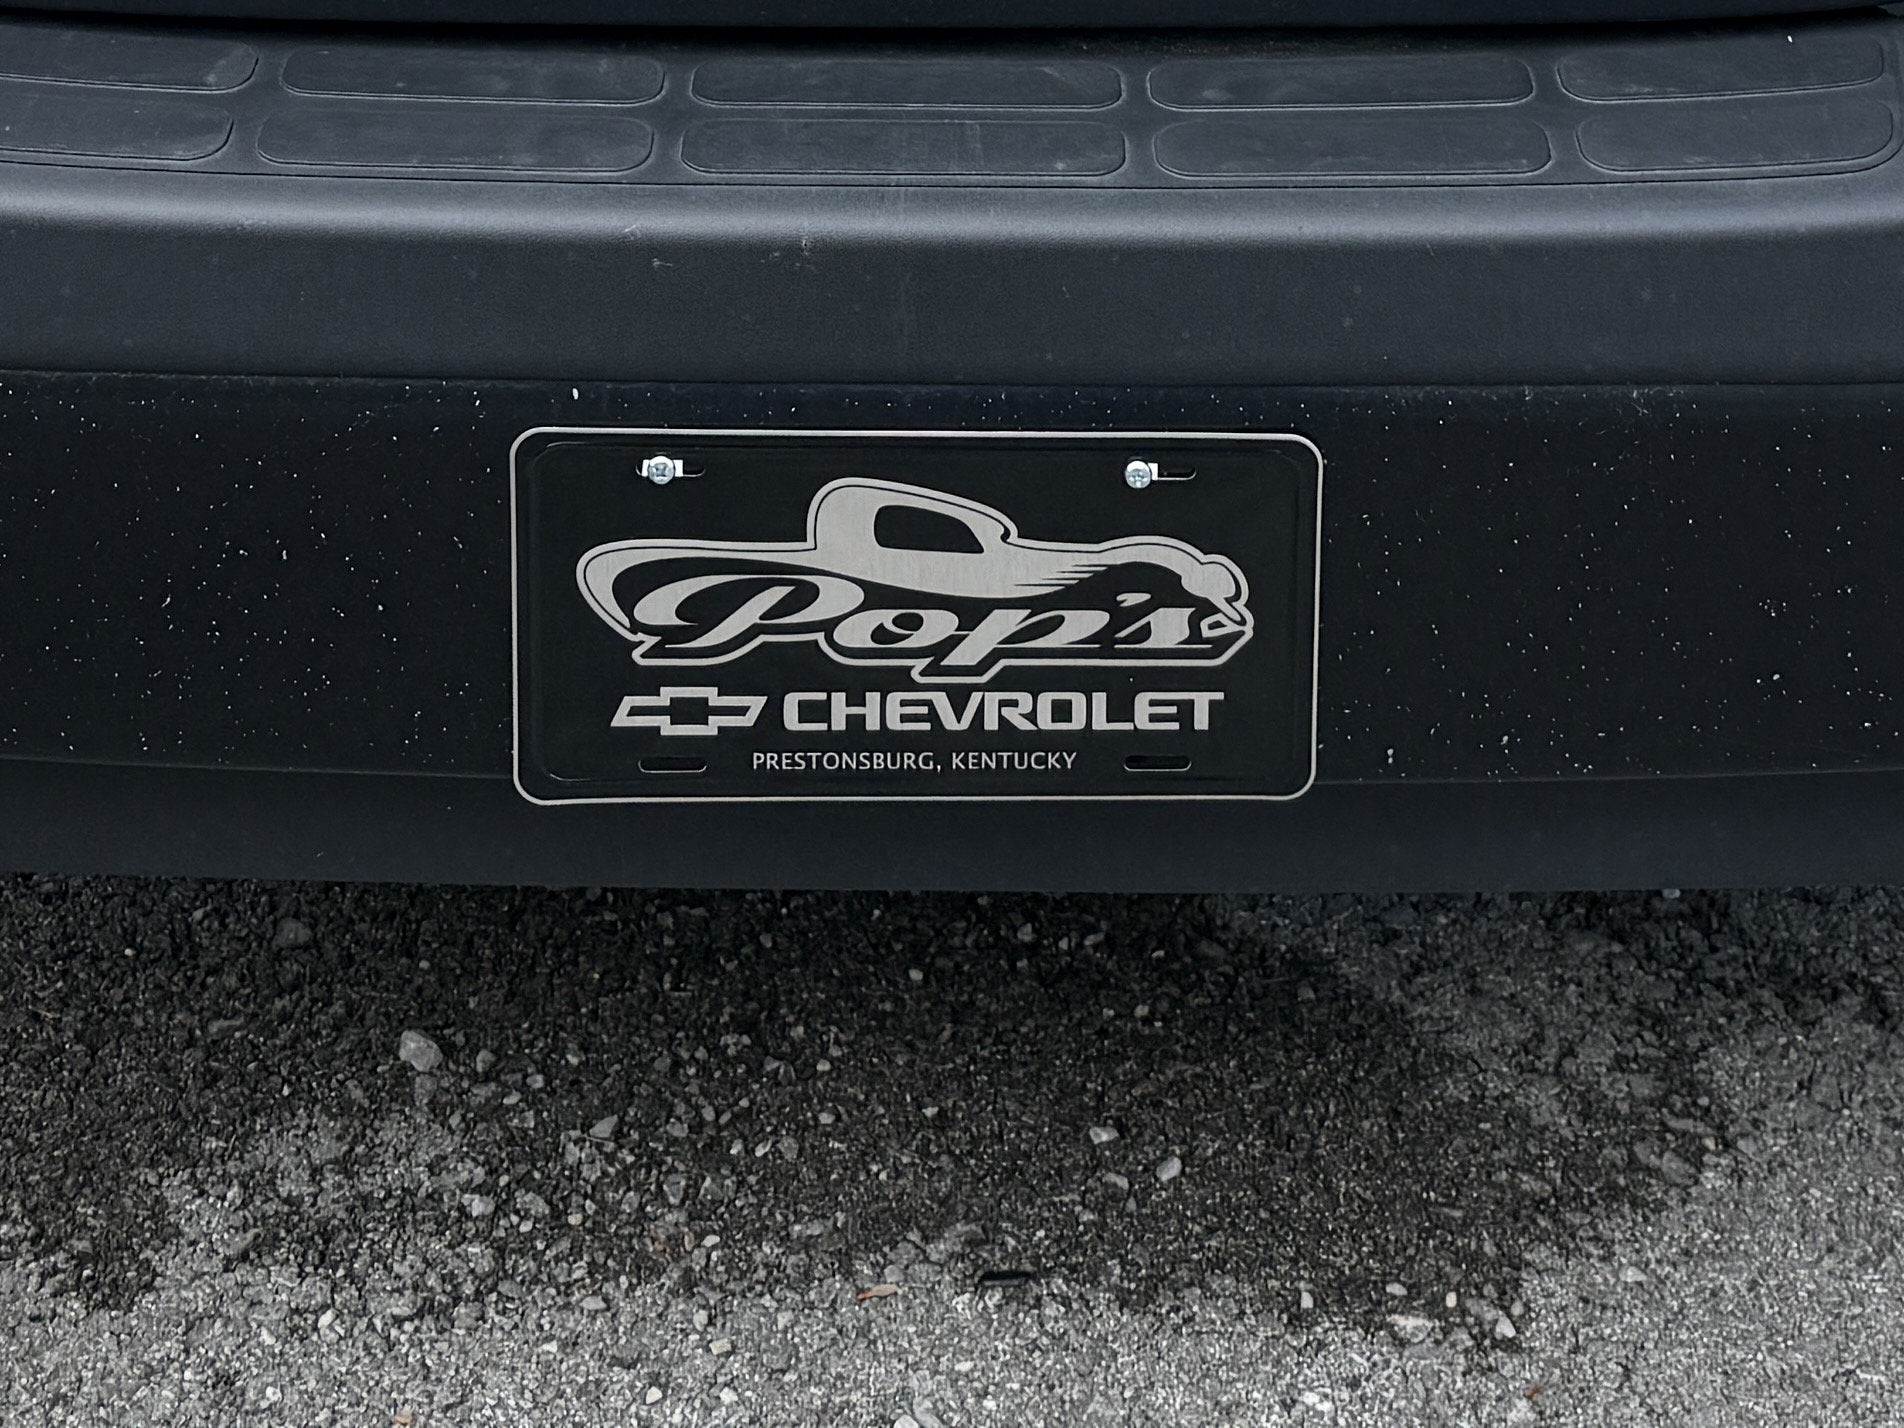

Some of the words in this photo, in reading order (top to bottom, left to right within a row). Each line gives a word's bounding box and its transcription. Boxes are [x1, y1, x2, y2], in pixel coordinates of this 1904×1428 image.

[632, 573, 1214, 667] Pop's
[783, 691, 1225, 731] CHEVROLET
[752, 751, 943, 774] PRESTONSBURG,
[951, 751, 1078, 771] KENTUCKY
